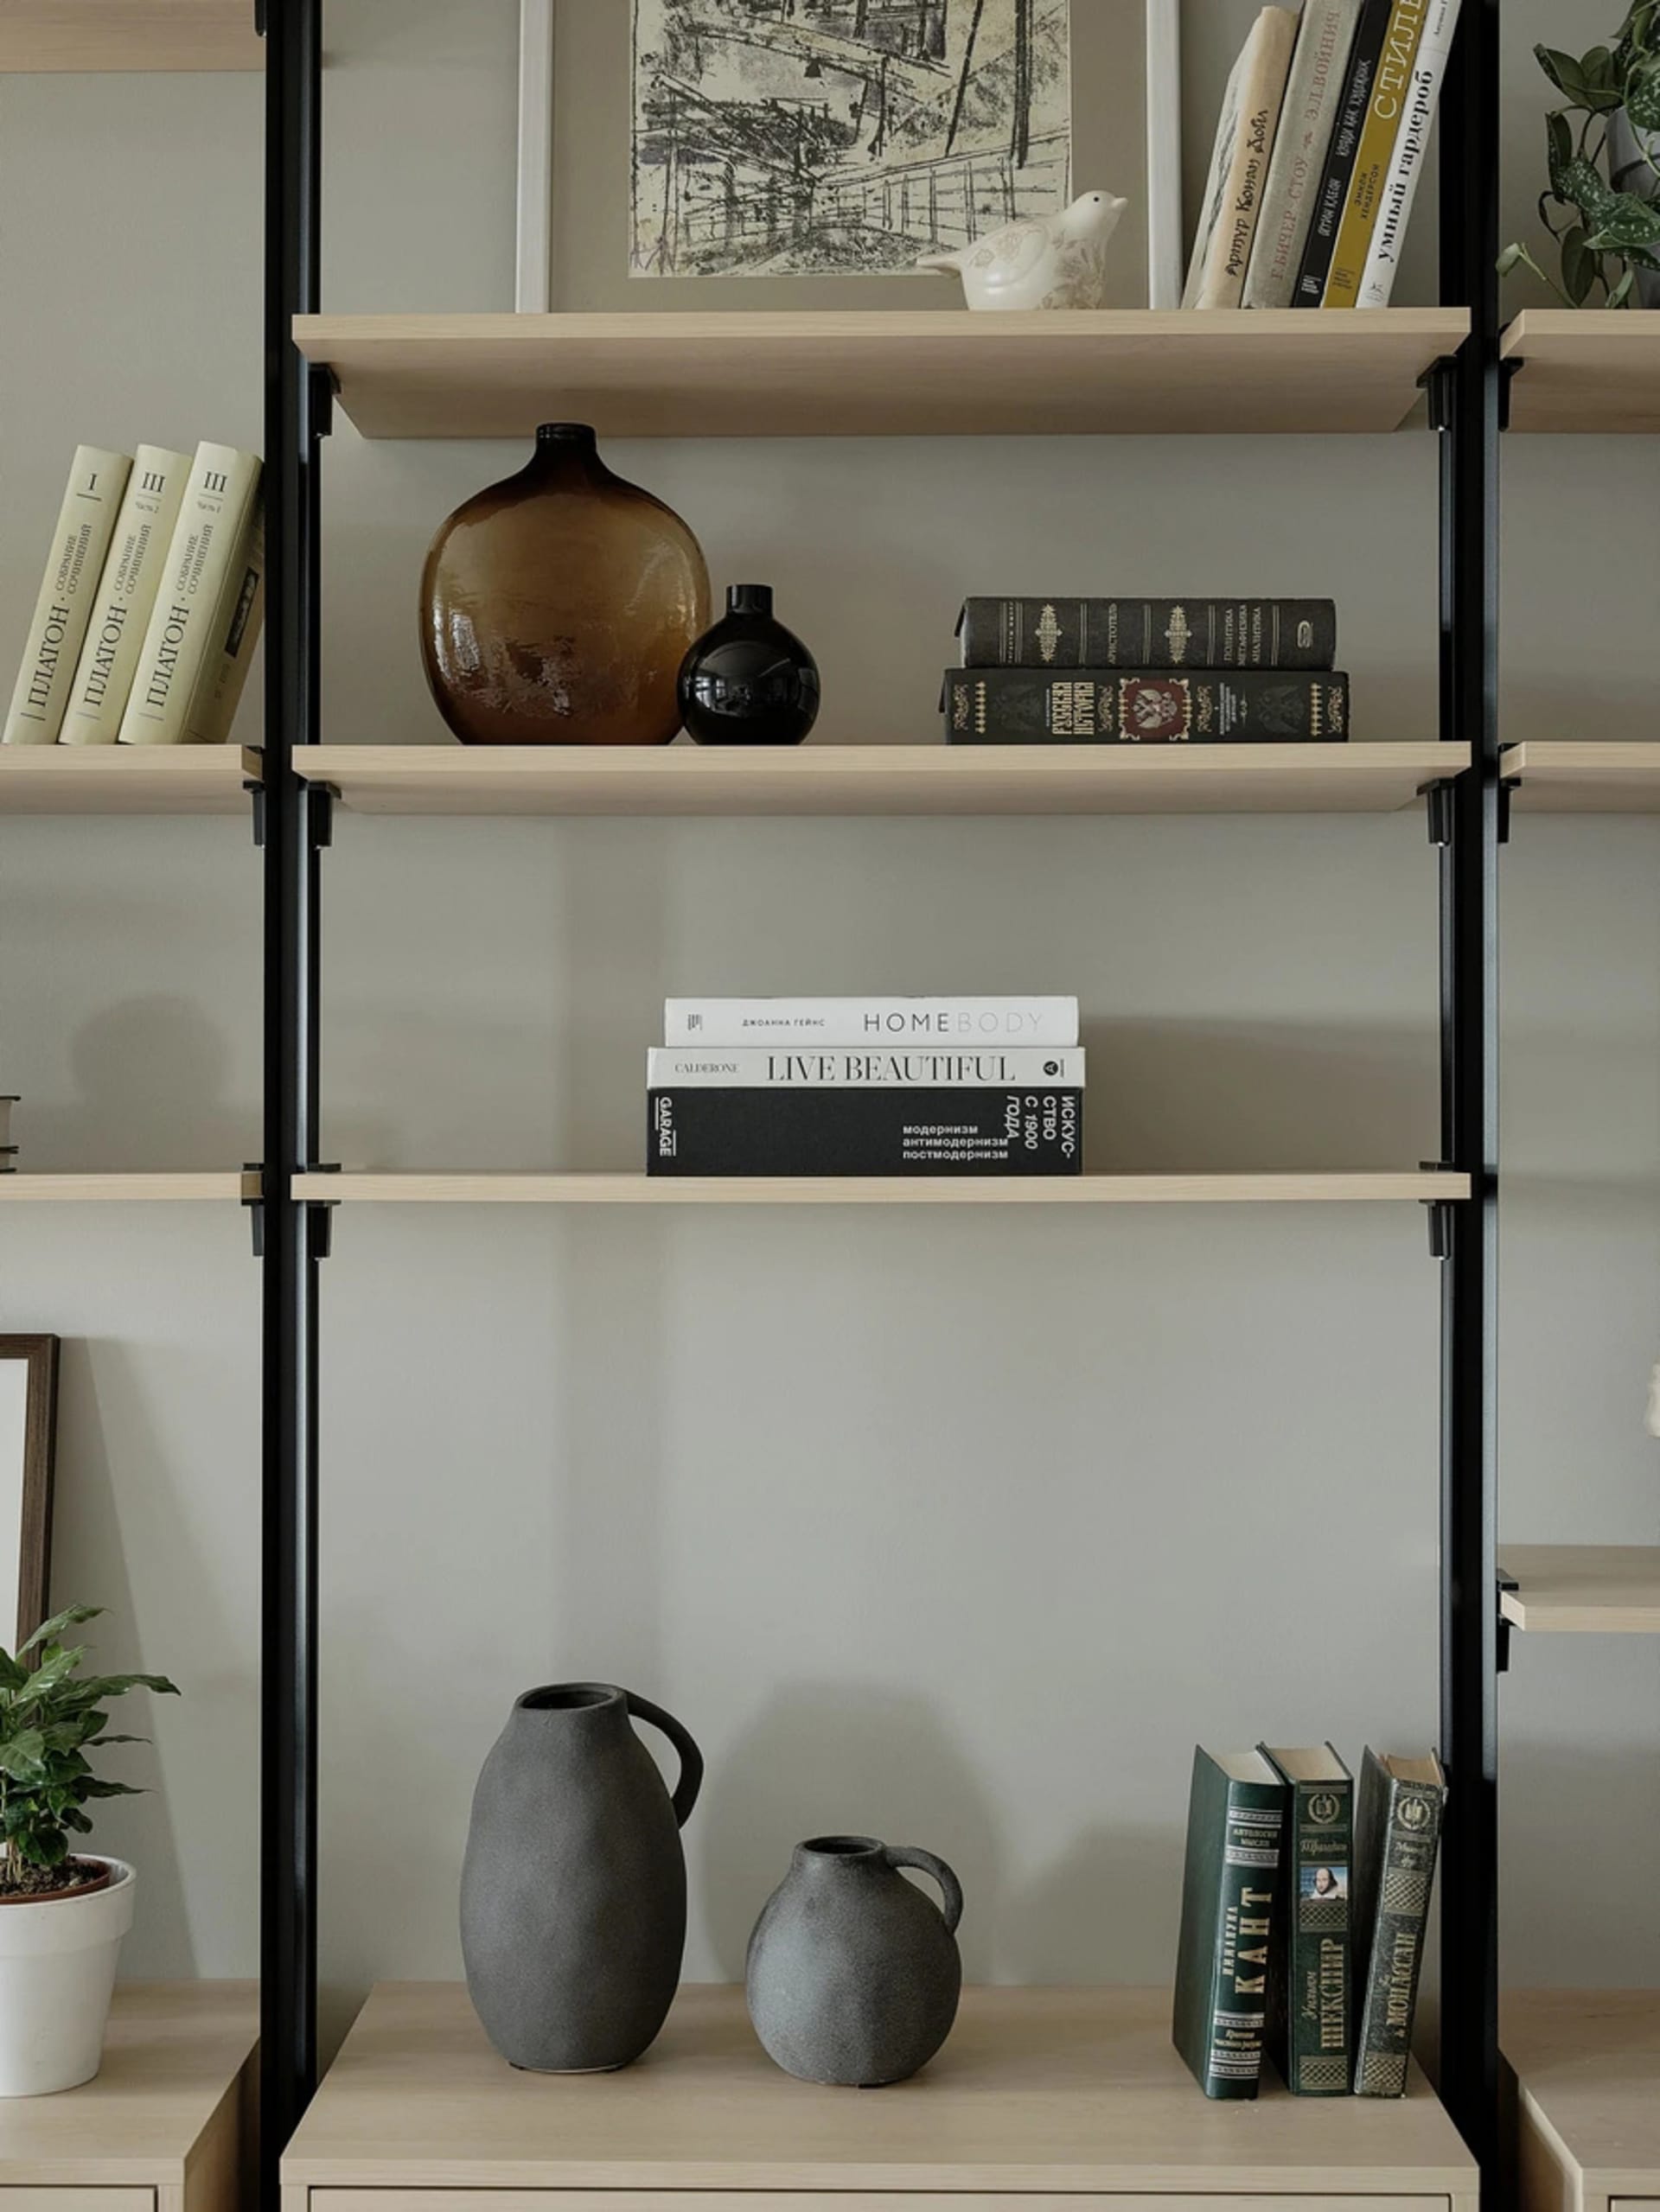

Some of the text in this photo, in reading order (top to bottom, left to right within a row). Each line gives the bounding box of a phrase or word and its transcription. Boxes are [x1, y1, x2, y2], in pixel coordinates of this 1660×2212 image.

[1224, 110, 1268, 277] Артур Конан Дойл
[1323, 177, 1342, 208] КЛЕОН
[1361, 163, 1379, 220] ХЕНДЕРСОН
[1378, 70, 1433, 263] умный гардероб
[142, 472, 165, 493] III
[203, 471, 227, 493] III
[54, 534, 78, 591] СОБРАНИЕ
[67, 524, 93, 595] СОЧИНЕНИЙ
[114, 535, 137, 591] СОБРАНИЕ
[124, 524, 152, 595] СОЧИНЕНИЙ
[176, 534, 199, 591] СОБРАНИЕ
[188, 524, 214, 595] СОЧИНЕНИЙ
[28, 605, 70, 707] ПЛАТОН
[84, 605, 127, 706] ПЛАТОН
[146, 605, 189, 707] ПЛАТОН
[1108, 602, 1118, 664] АРИСТОТЕЛЬ
[1223, 609, 1233, 660] ПОЛИТИКА
[1237, 605, 1247, 666] МЕТАФИЗИКА
[1252, 607, 1261, 664] АНАЛИТИКА
[1052, 682, 1072, 735] РУССКАЯ
[1073, 682, 1095, 735] ИСТОРИЯ
[794, 1018, 825, 1027] ГЕЙНС
[674, 1063, 739, 1074] CALDERONE
[767, 1055, 1016, 1081] LIVE BEAUTIFUL
[660, 1096, 672, 1157] GARAGE
[903, 1125, 978, 1136] модернизм
[903, 1138, 1008, 1149] антимодернизм
[1005, 1095, 1019, 1138] ГОДА
[1025, 1095, 1038, 1150] С 1900
[1043, 1095, 1057, 1140] СТВО
[1061, 1096, 1076, 1158] ИСКУС-
[903, 1151, 1008, 1161] постмодернизм
[1235, 1887, 1272, 1994] КАНТ
[1320, 1939, 1344, 2049] ШЕКСПИР
[1386, 1933, 1416, 2026] МОПАССАН
